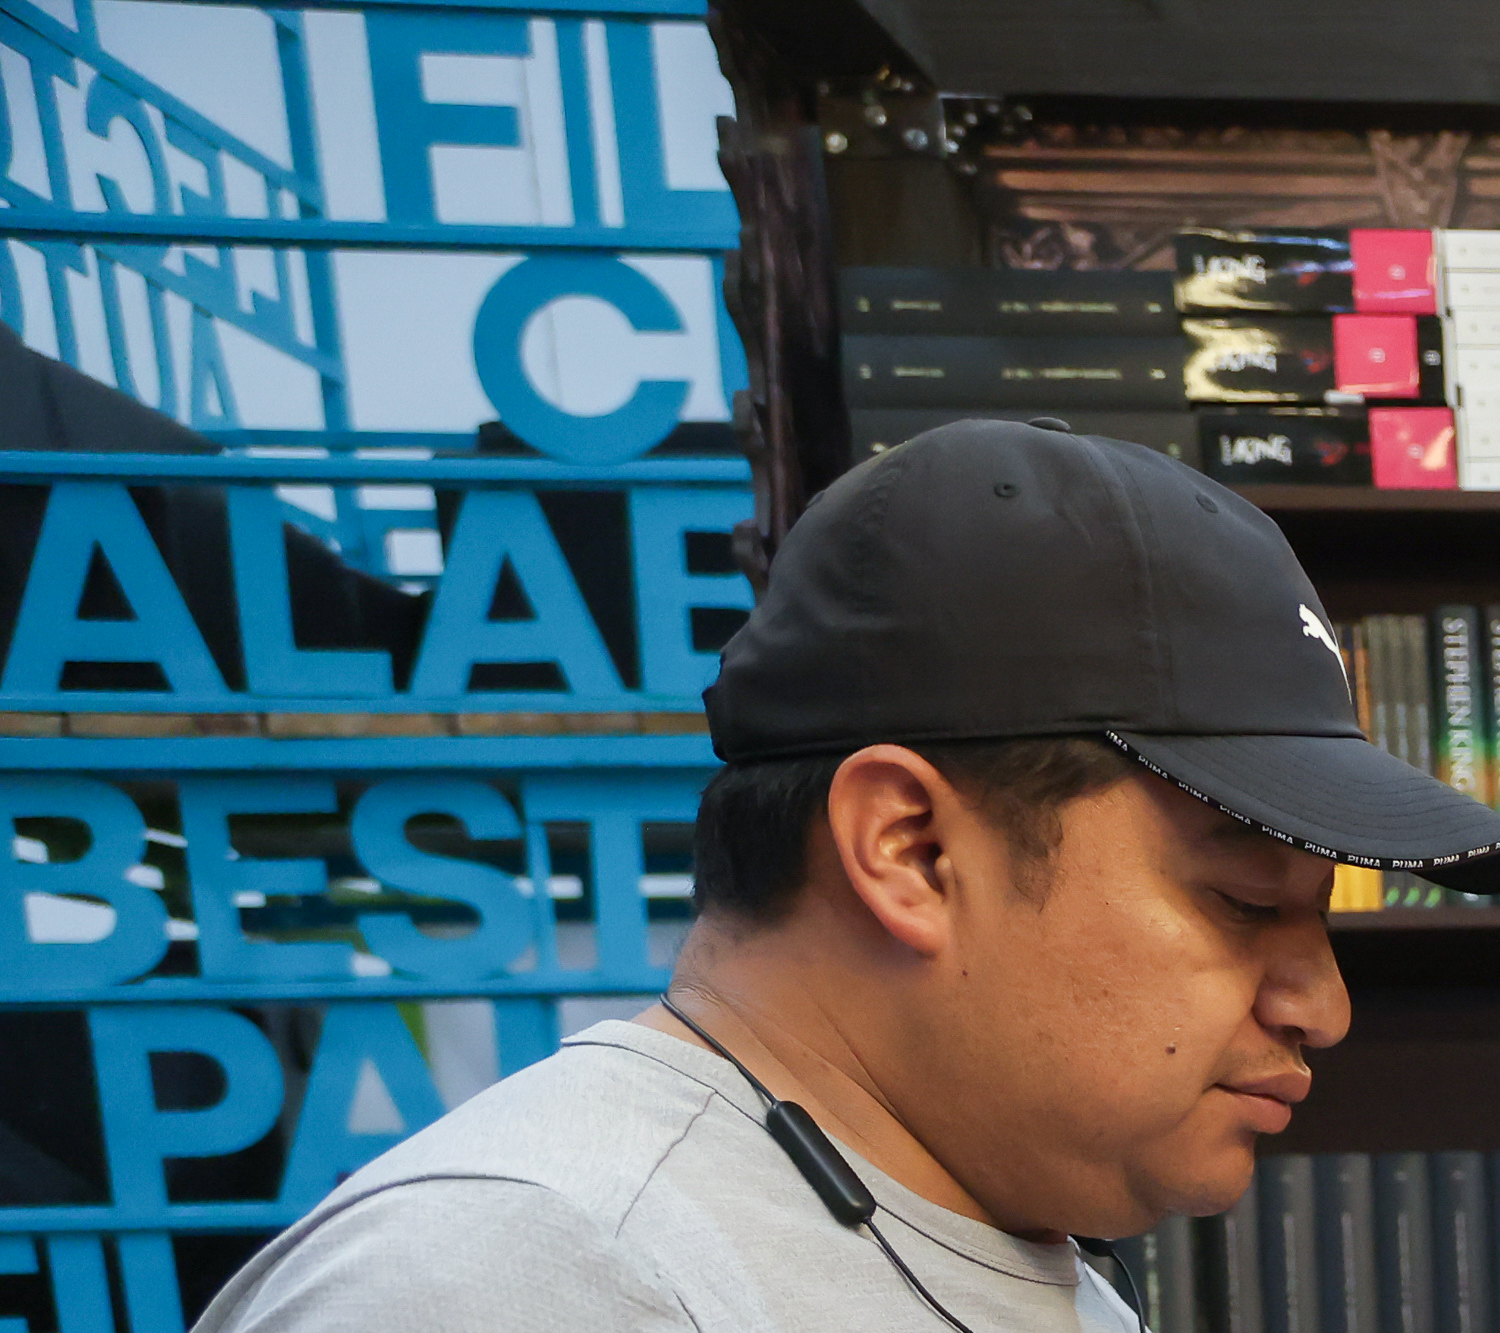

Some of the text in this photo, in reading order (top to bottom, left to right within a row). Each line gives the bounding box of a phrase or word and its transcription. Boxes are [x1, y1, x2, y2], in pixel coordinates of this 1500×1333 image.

[1138, 754, 1168, 780] PUMA
[1261, 825, 1293, 844] PUMA
[1304, 842, 1337, 859] PUMA
[1347, 854, 1380, 868] PUMA
[1393, 859, 1423, 870] PUMA
